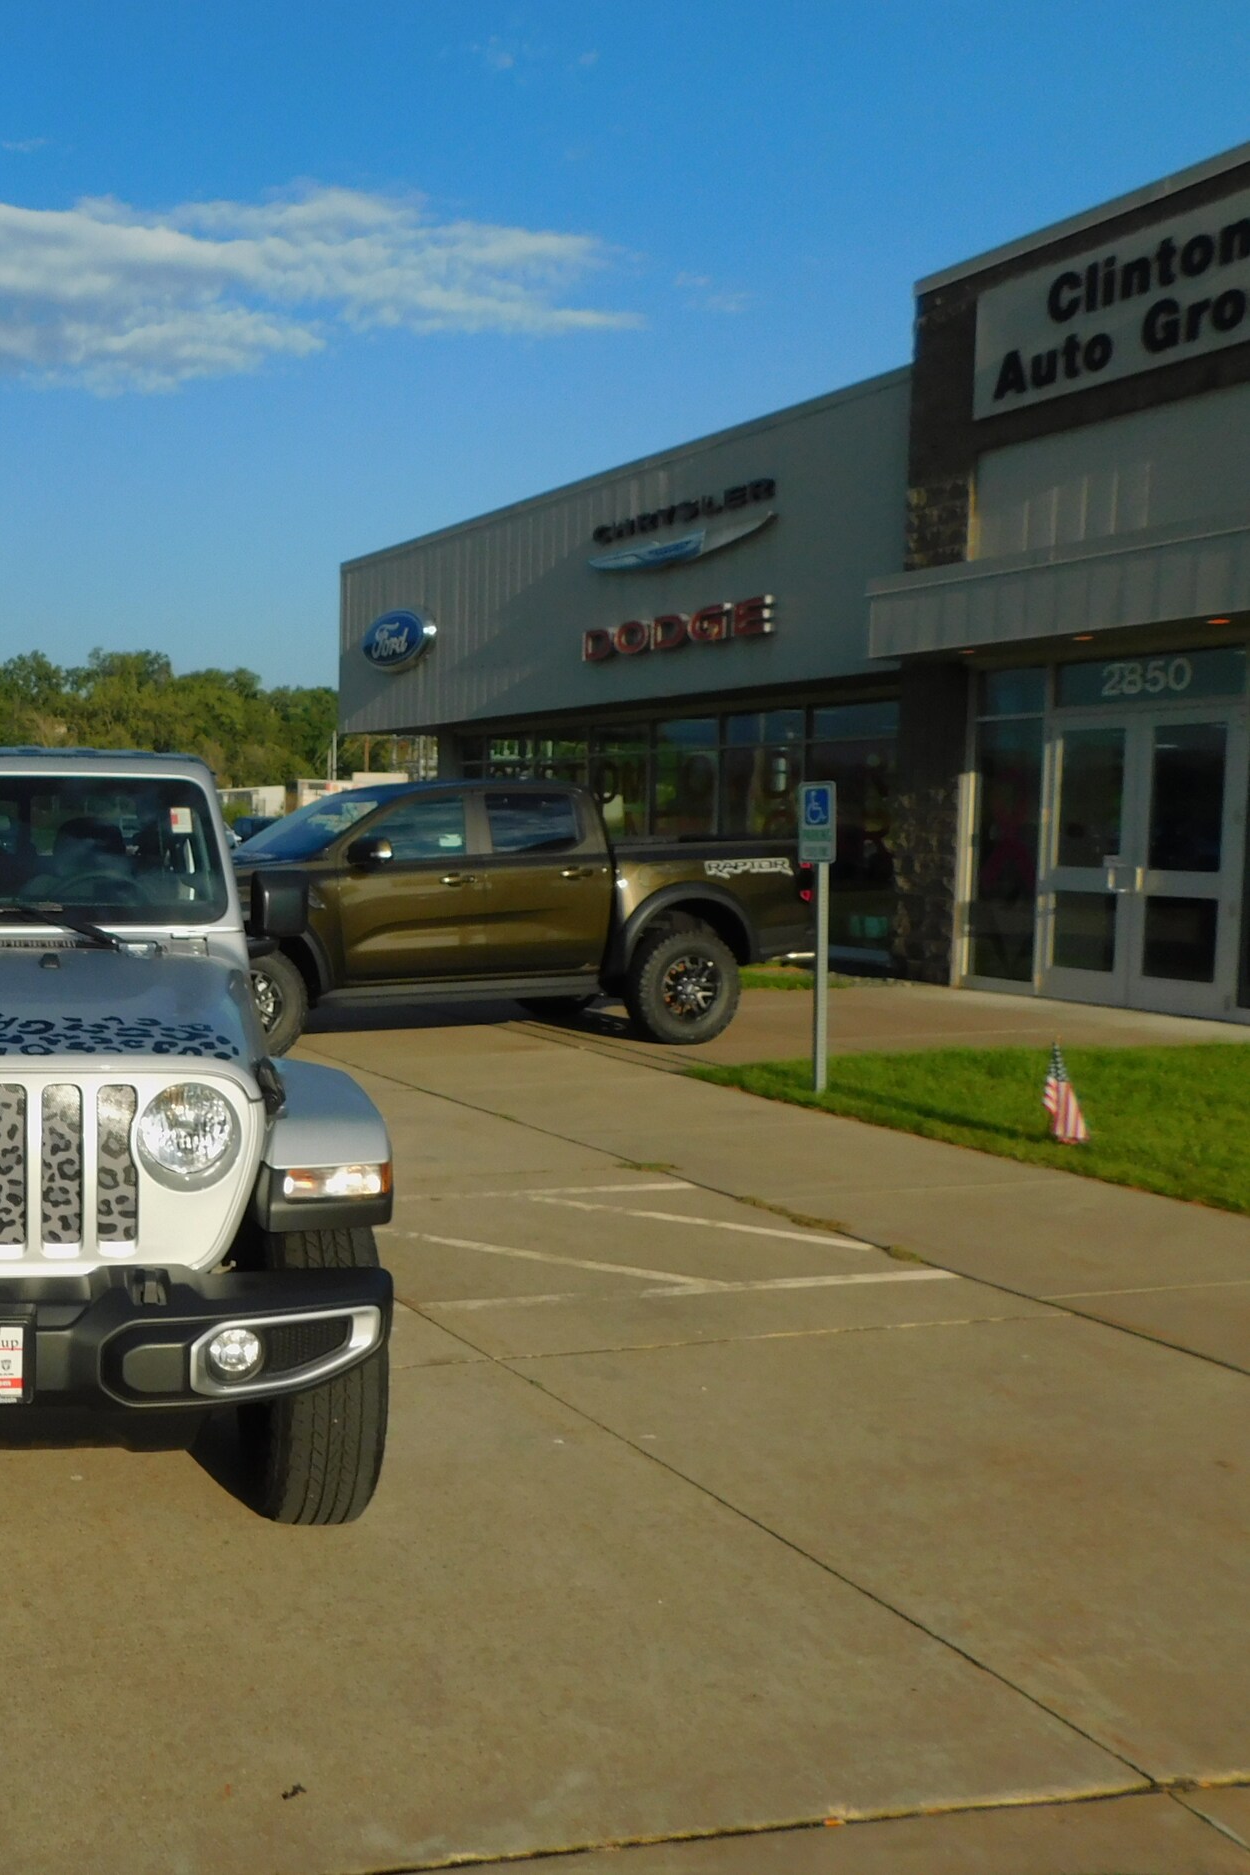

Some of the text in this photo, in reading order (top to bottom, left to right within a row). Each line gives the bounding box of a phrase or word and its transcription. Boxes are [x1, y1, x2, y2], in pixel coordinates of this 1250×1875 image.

[1047, 217, 1250, 323] Clinton
[993, 333, 1113, 400] Auto
[592, 477, 777, 543] CHRYSLER
[371, 621, 409, 659] Ford
[581, 594, 776, 662] DODGE
[1101, 657, 1192, 697] 2850
[704, 857, 794, 879] RAPTOR
